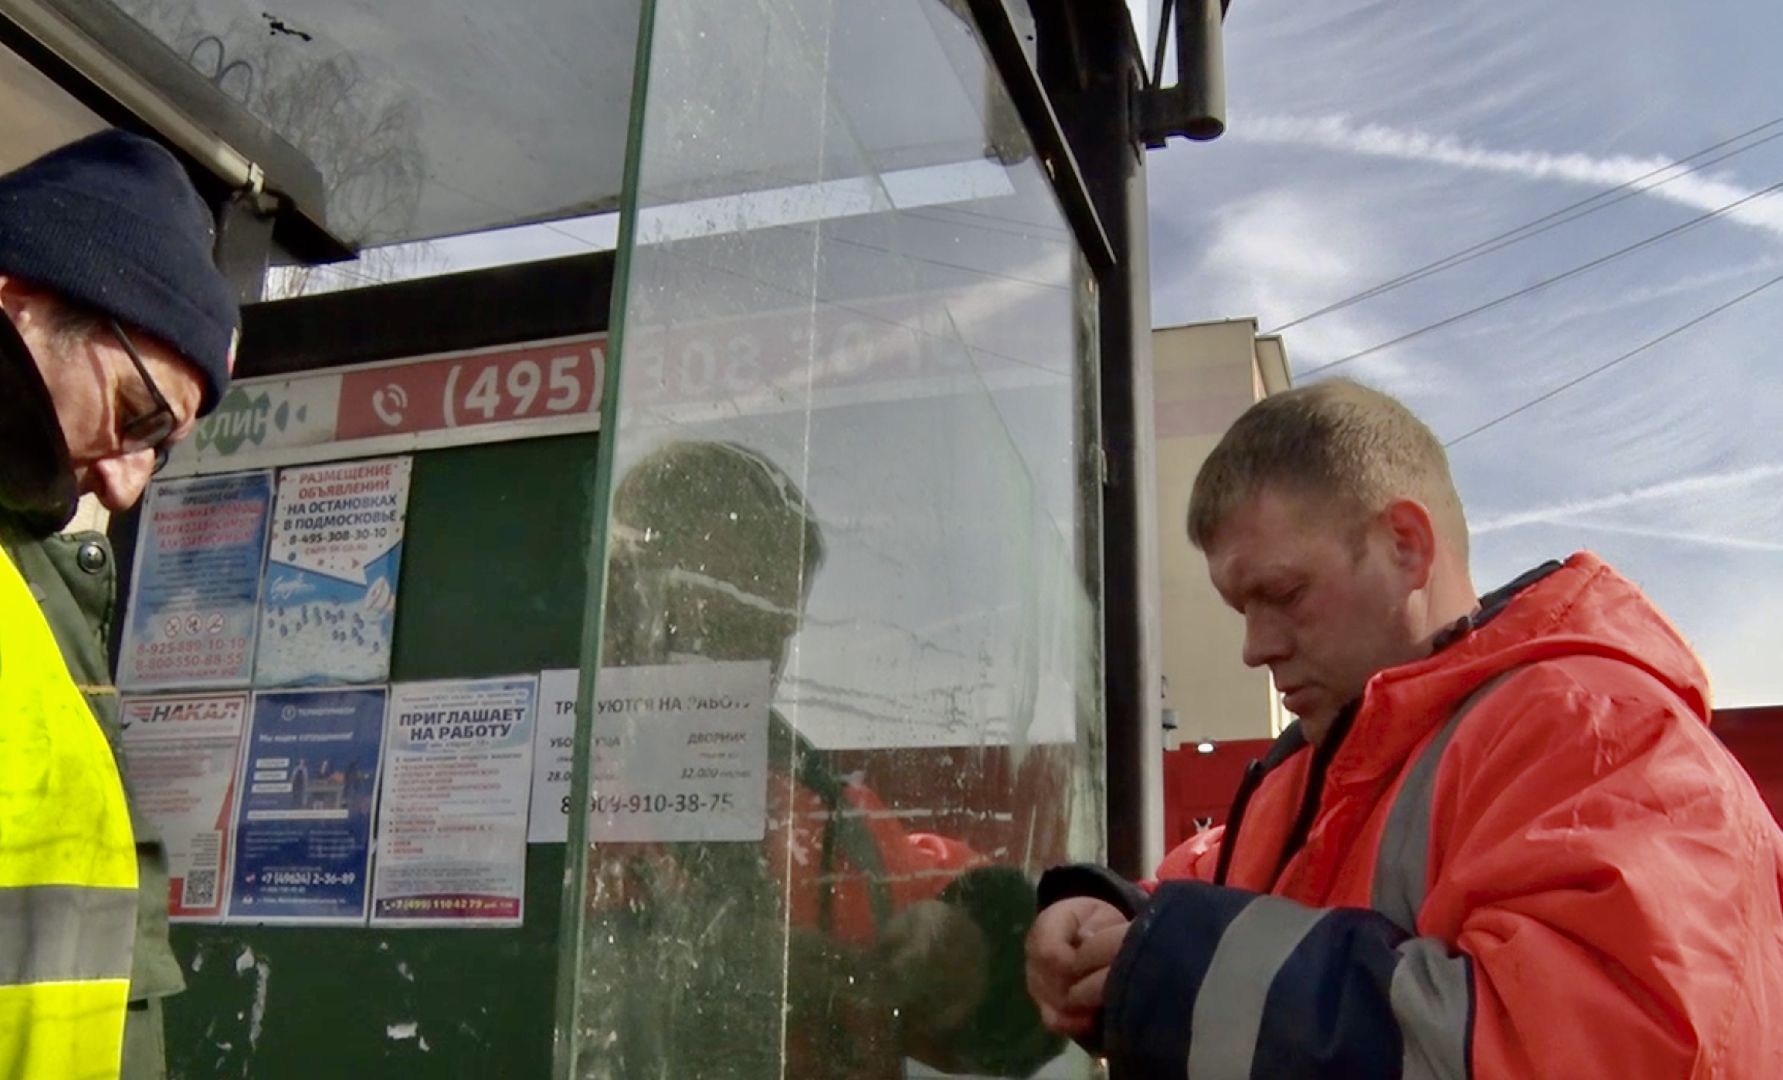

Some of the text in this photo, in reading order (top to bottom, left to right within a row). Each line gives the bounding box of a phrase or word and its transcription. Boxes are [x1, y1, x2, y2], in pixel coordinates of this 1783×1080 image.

[443, 348, 605, 427] (495)
[300, 463, 392, 484] РАЗМЕЩЕНИЕ
[287, 494, 397, 516] НА ОСТАНОВКАХ
[283, 510, 396, 531] В ПОДМОСКОВЬЕ
[152, 702, 240, 722] НАКАЛ
[556, 698, 654, 715] ТРУЮТСЯ
[659, 697, 682, 711] НА
[400, 708, 525, 726] ПРИГЛАШАЕТ
[410, 723, 512, 741] НА РАБОТУ
